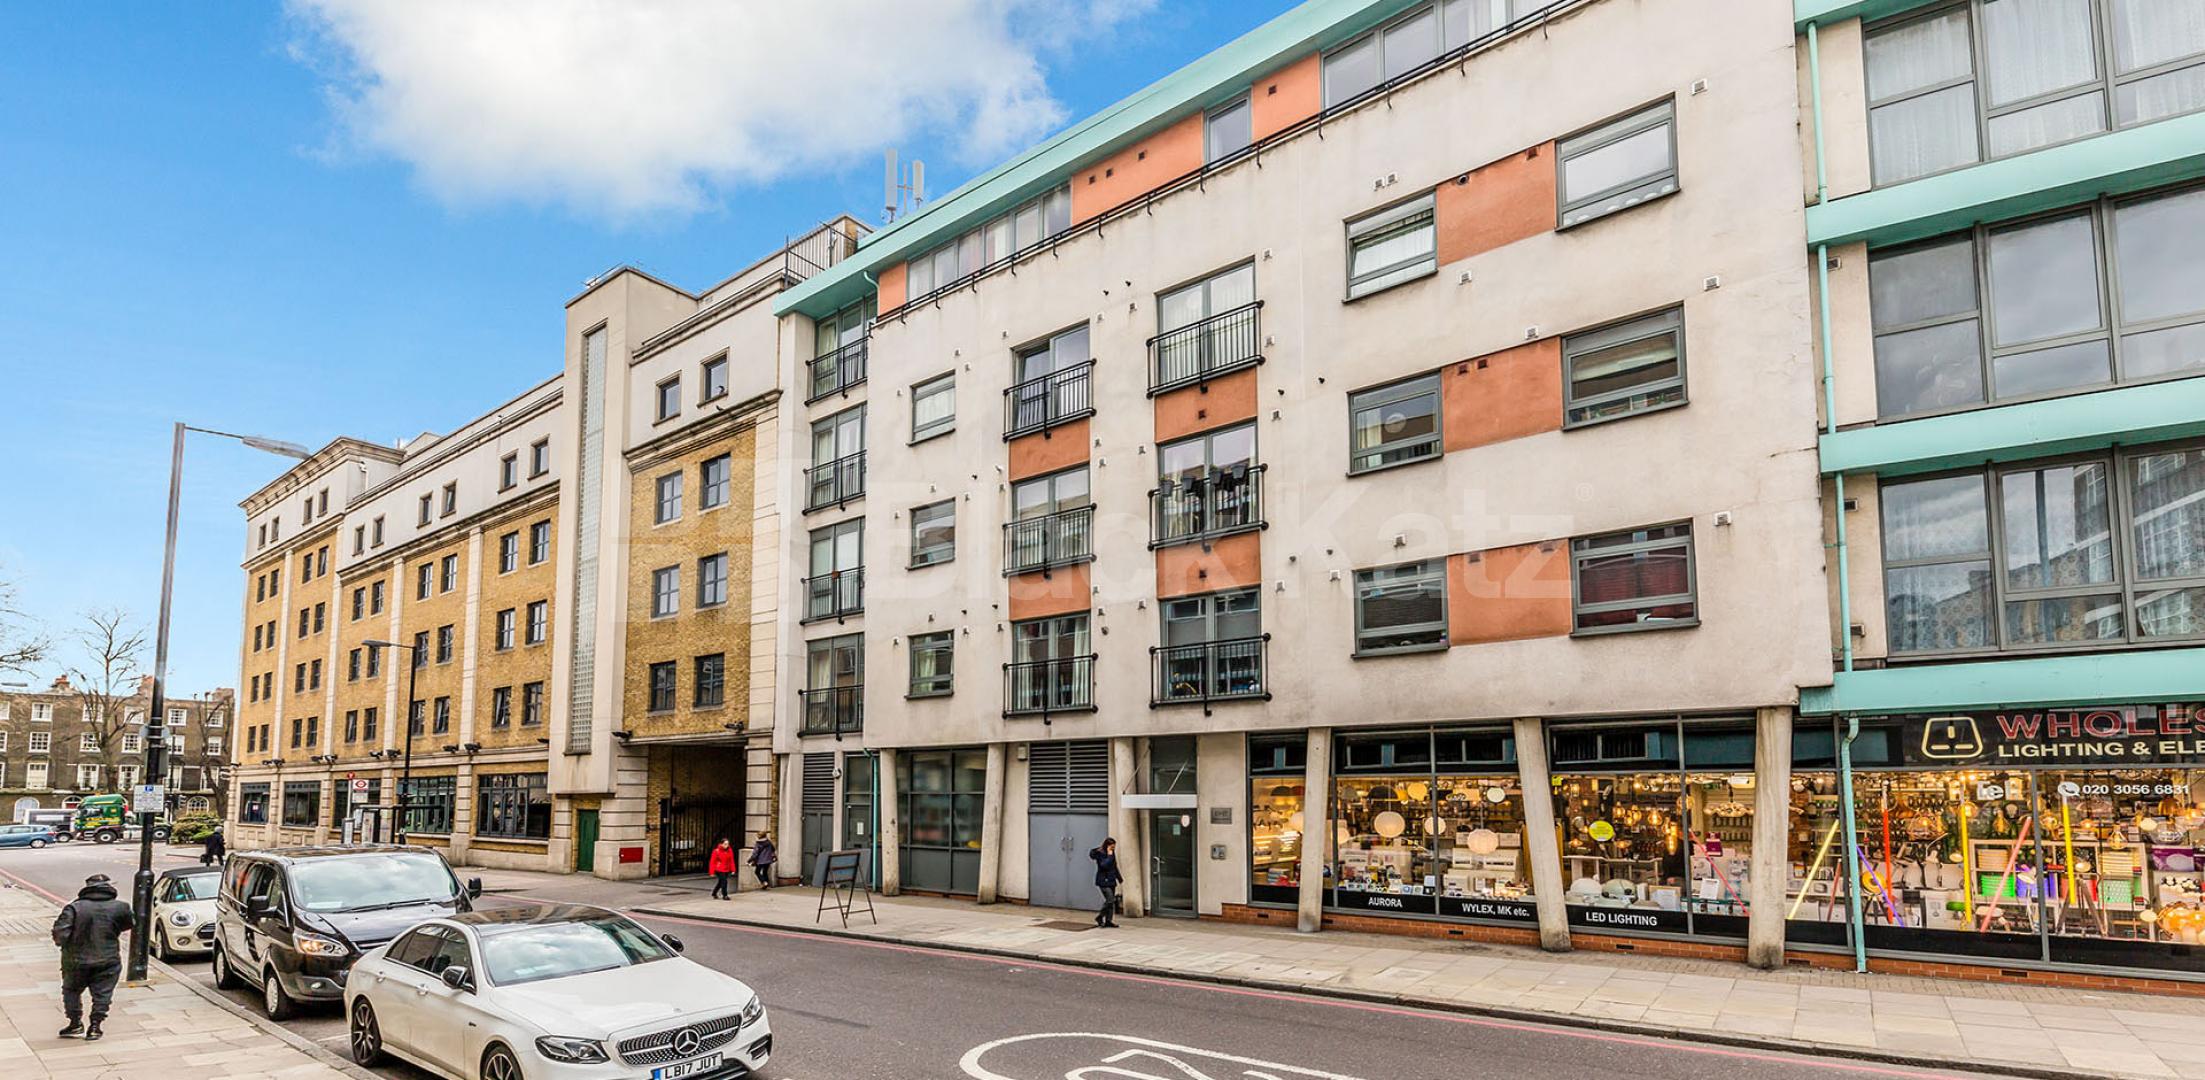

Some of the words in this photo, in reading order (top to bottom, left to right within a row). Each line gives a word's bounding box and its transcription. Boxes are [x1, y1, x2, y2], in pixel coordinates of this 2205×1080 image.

[1998, 742, 2124, 757] LIGHTING
[2132, 741, 2151, 755] &
[2082, 784, 2109, 795] 020
[2113, 784, 2150, 795] 3056
[2154, 784, 2189, 795] 6831
[1368, 896, 1403, 908] AURORA
[1462, 903, 1496, 915] WYLEX,
[1497, 905, 1512, 916] MK
[1513, 908, 1530, 917] etc.
[1585, 911, 1606, 923] LED
[1608, 913, 1658, 926] LIGHTING
[665, 1063, 693, 1079] LB17
[696, 1056, 718, 1071] JUT
